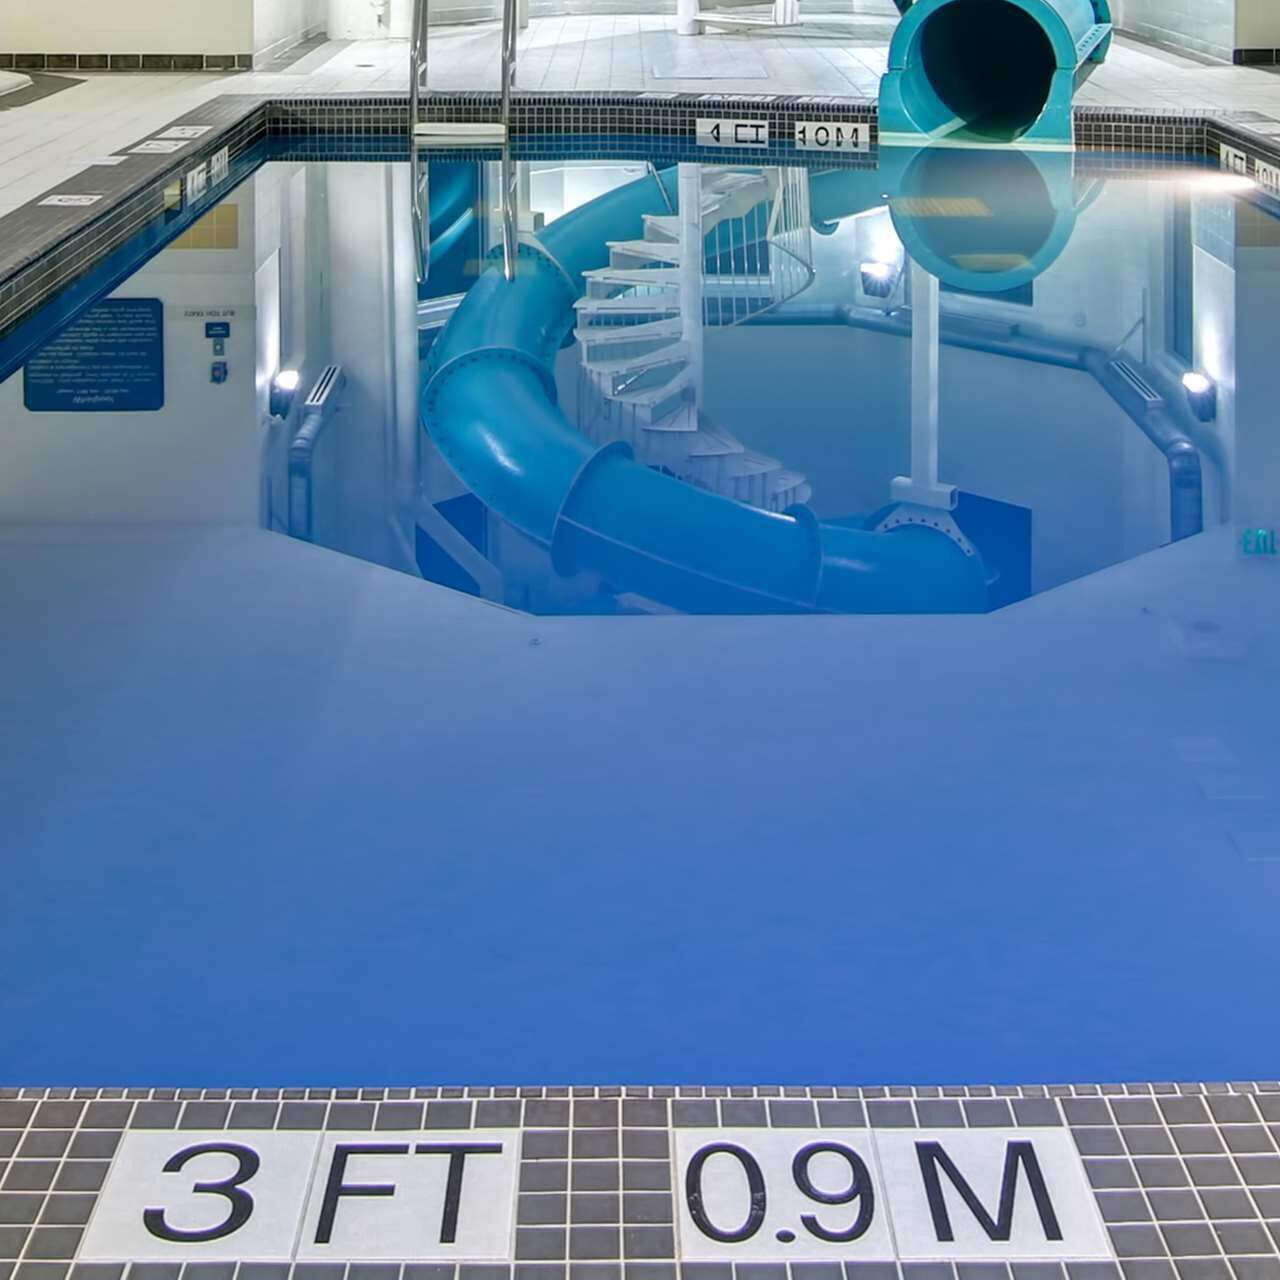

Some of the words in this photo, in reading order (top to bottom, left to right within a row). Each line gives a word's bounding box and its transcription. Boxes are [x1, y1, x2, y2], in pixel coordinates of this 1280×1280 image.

[143, 1141, 261, 1243] 3
[313, 1142, 504, 1244] FT
[685, 1140, 875, 1244] 0.9
[914, 1139, 1064, 1243] M
